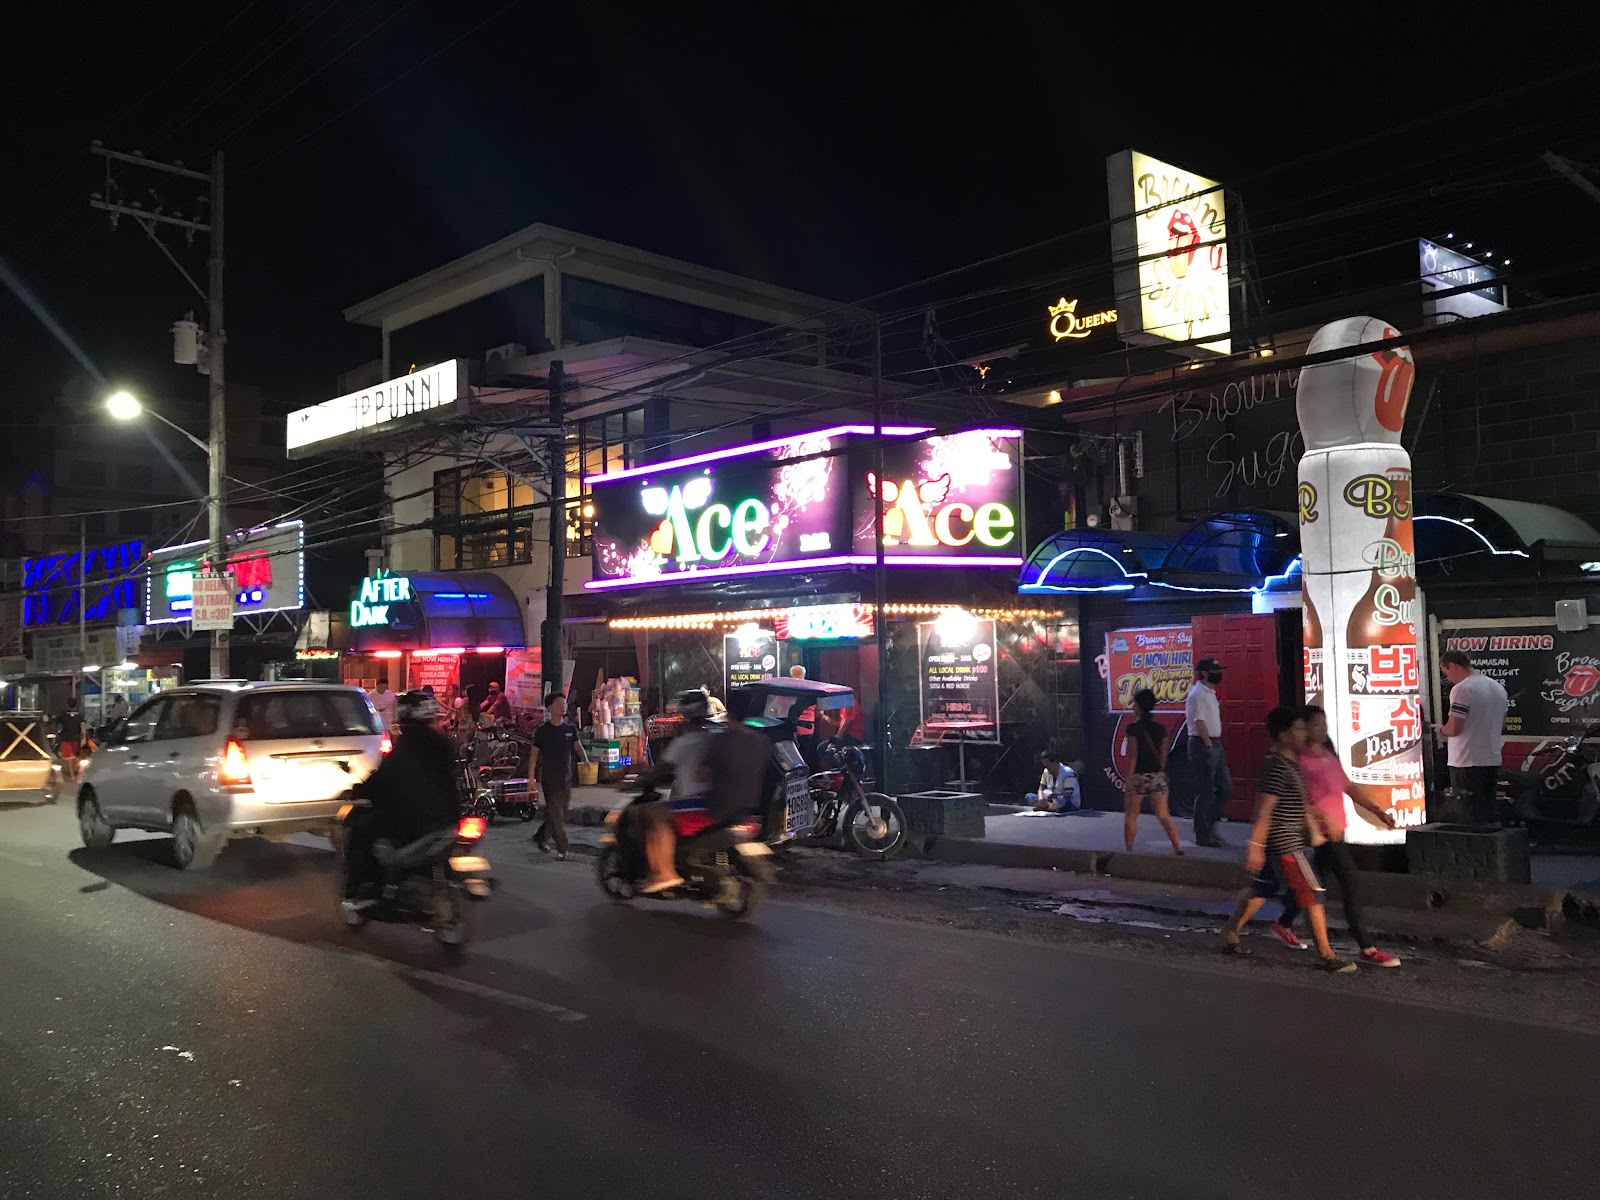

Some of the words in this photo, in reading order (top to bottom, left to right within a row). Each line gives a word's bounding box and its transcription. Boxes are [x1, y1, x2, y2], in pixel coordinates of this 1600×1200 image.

[882, 479, 1015, 547] Ace
[360, 576, 411, 603] AFTER
[1446, 637, 1487, 652] NOW
[1489, 634, 1554, 651] HIRING
[1131, 653, 1143, 669] IS
[1144, 651, 1169, 669] NOW
